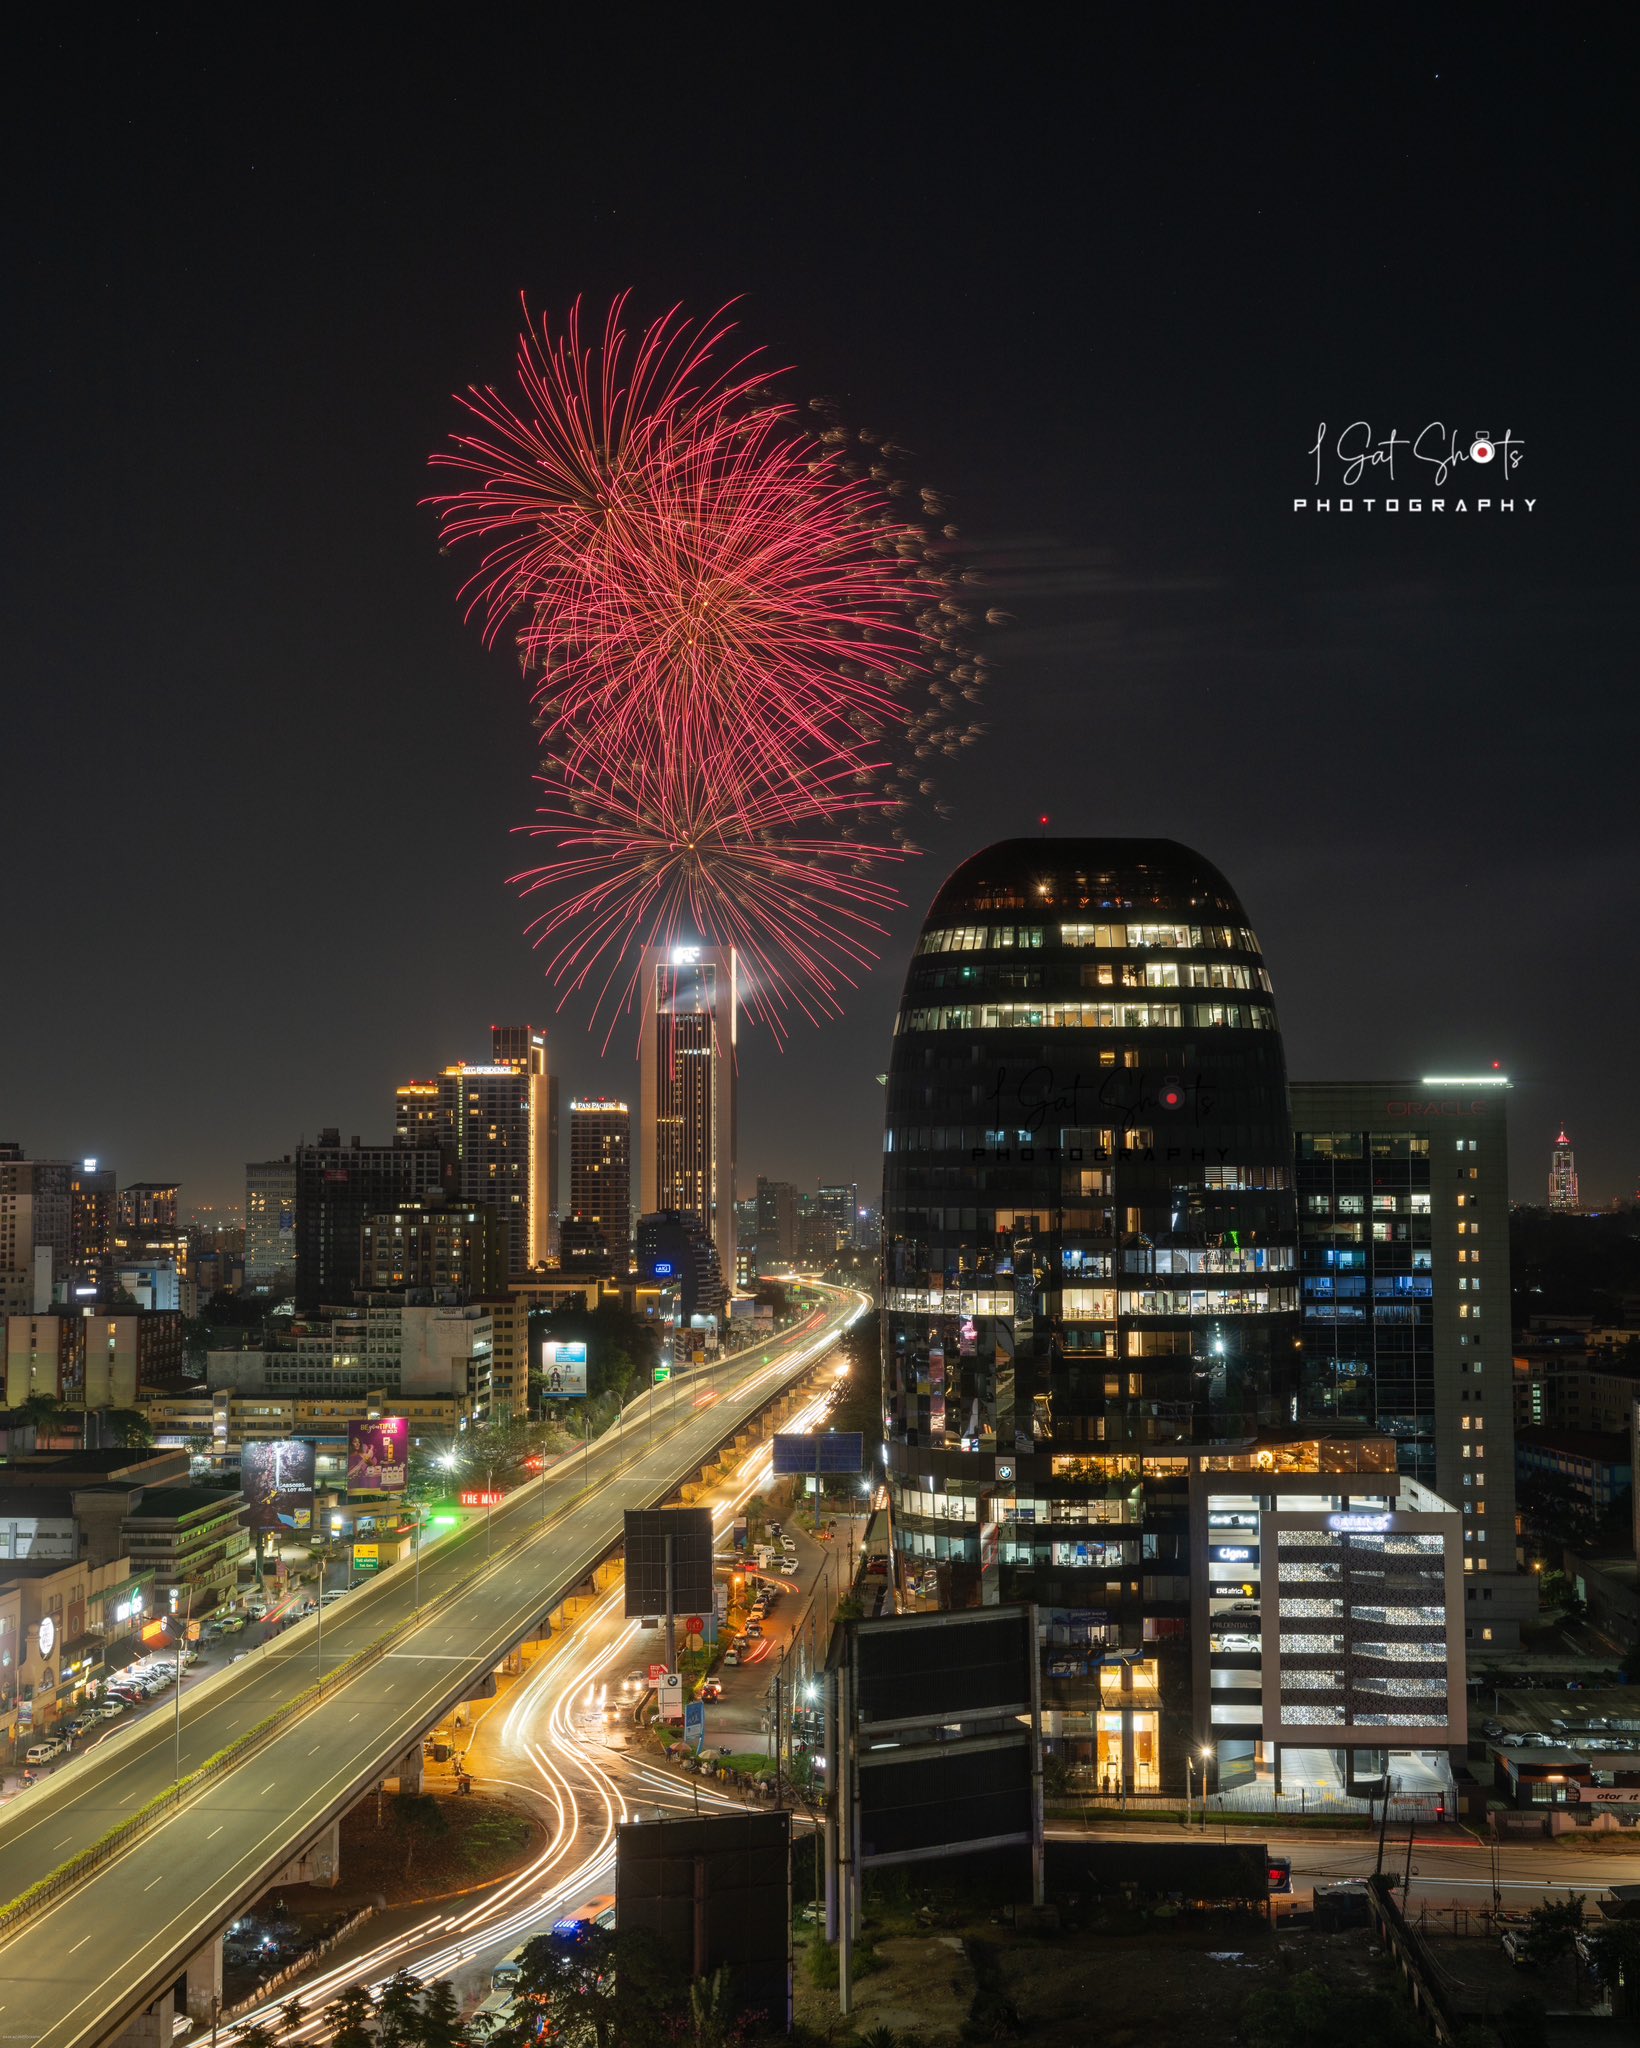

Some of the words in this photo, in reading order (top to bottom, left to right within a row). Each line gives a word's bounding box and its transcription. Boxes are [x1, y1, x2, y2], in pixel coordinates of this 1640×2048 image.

[477, 1066, 512, 1075] RESIDENCE
[592, 1102, 616, 1110] PACIFIC
[1386, 1101, 1489, 1117] ORACLE
[462, 1494, 478, 1504] THE
[1219, 1548, 1249, 1561] Cigna
[1213, 1621, 1249, 1629] PRUDENTIAL
